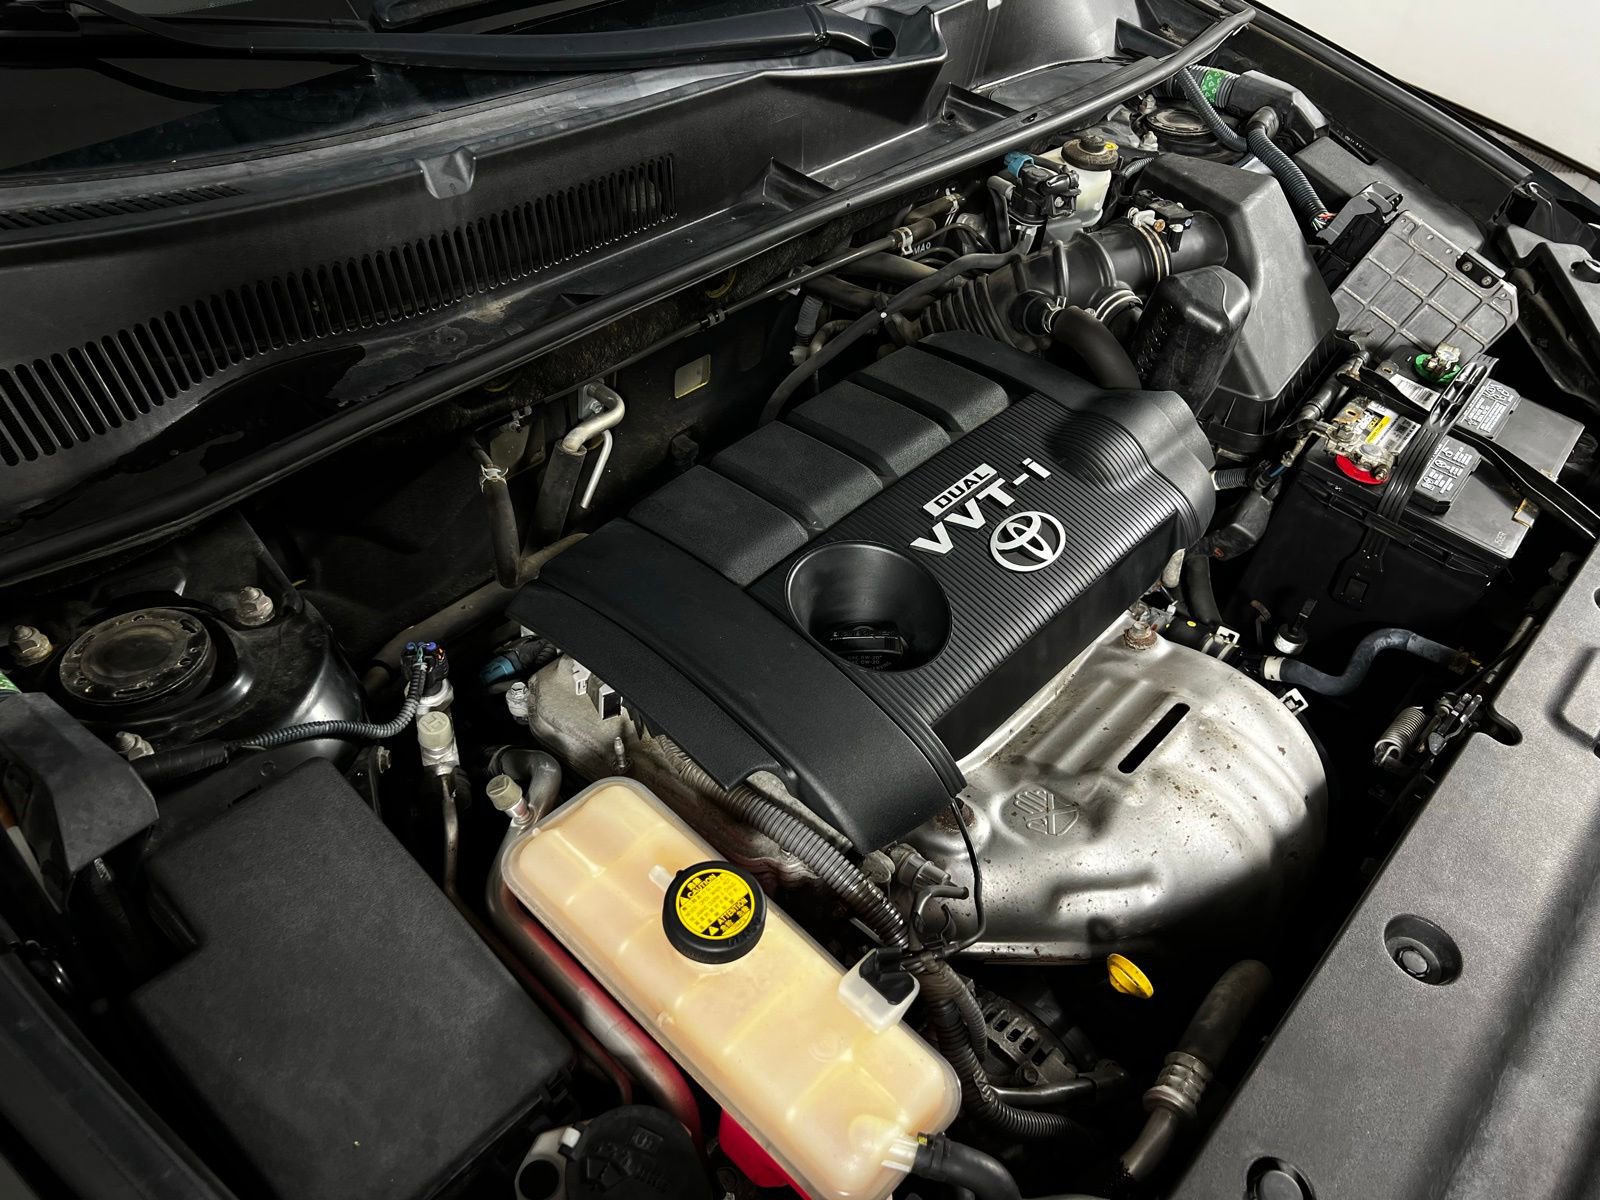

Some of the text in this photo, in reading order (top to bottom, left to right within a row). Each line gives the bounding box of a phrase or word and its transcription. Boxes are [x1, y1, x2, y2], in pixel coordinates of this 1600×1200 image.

[909, 457, 1051, 555] VVT-i
[933, 471, 990, 509] DUAL
[687, 873, 718, 898] CAUTION
[717, 897, 748, 925] ATTENTION
